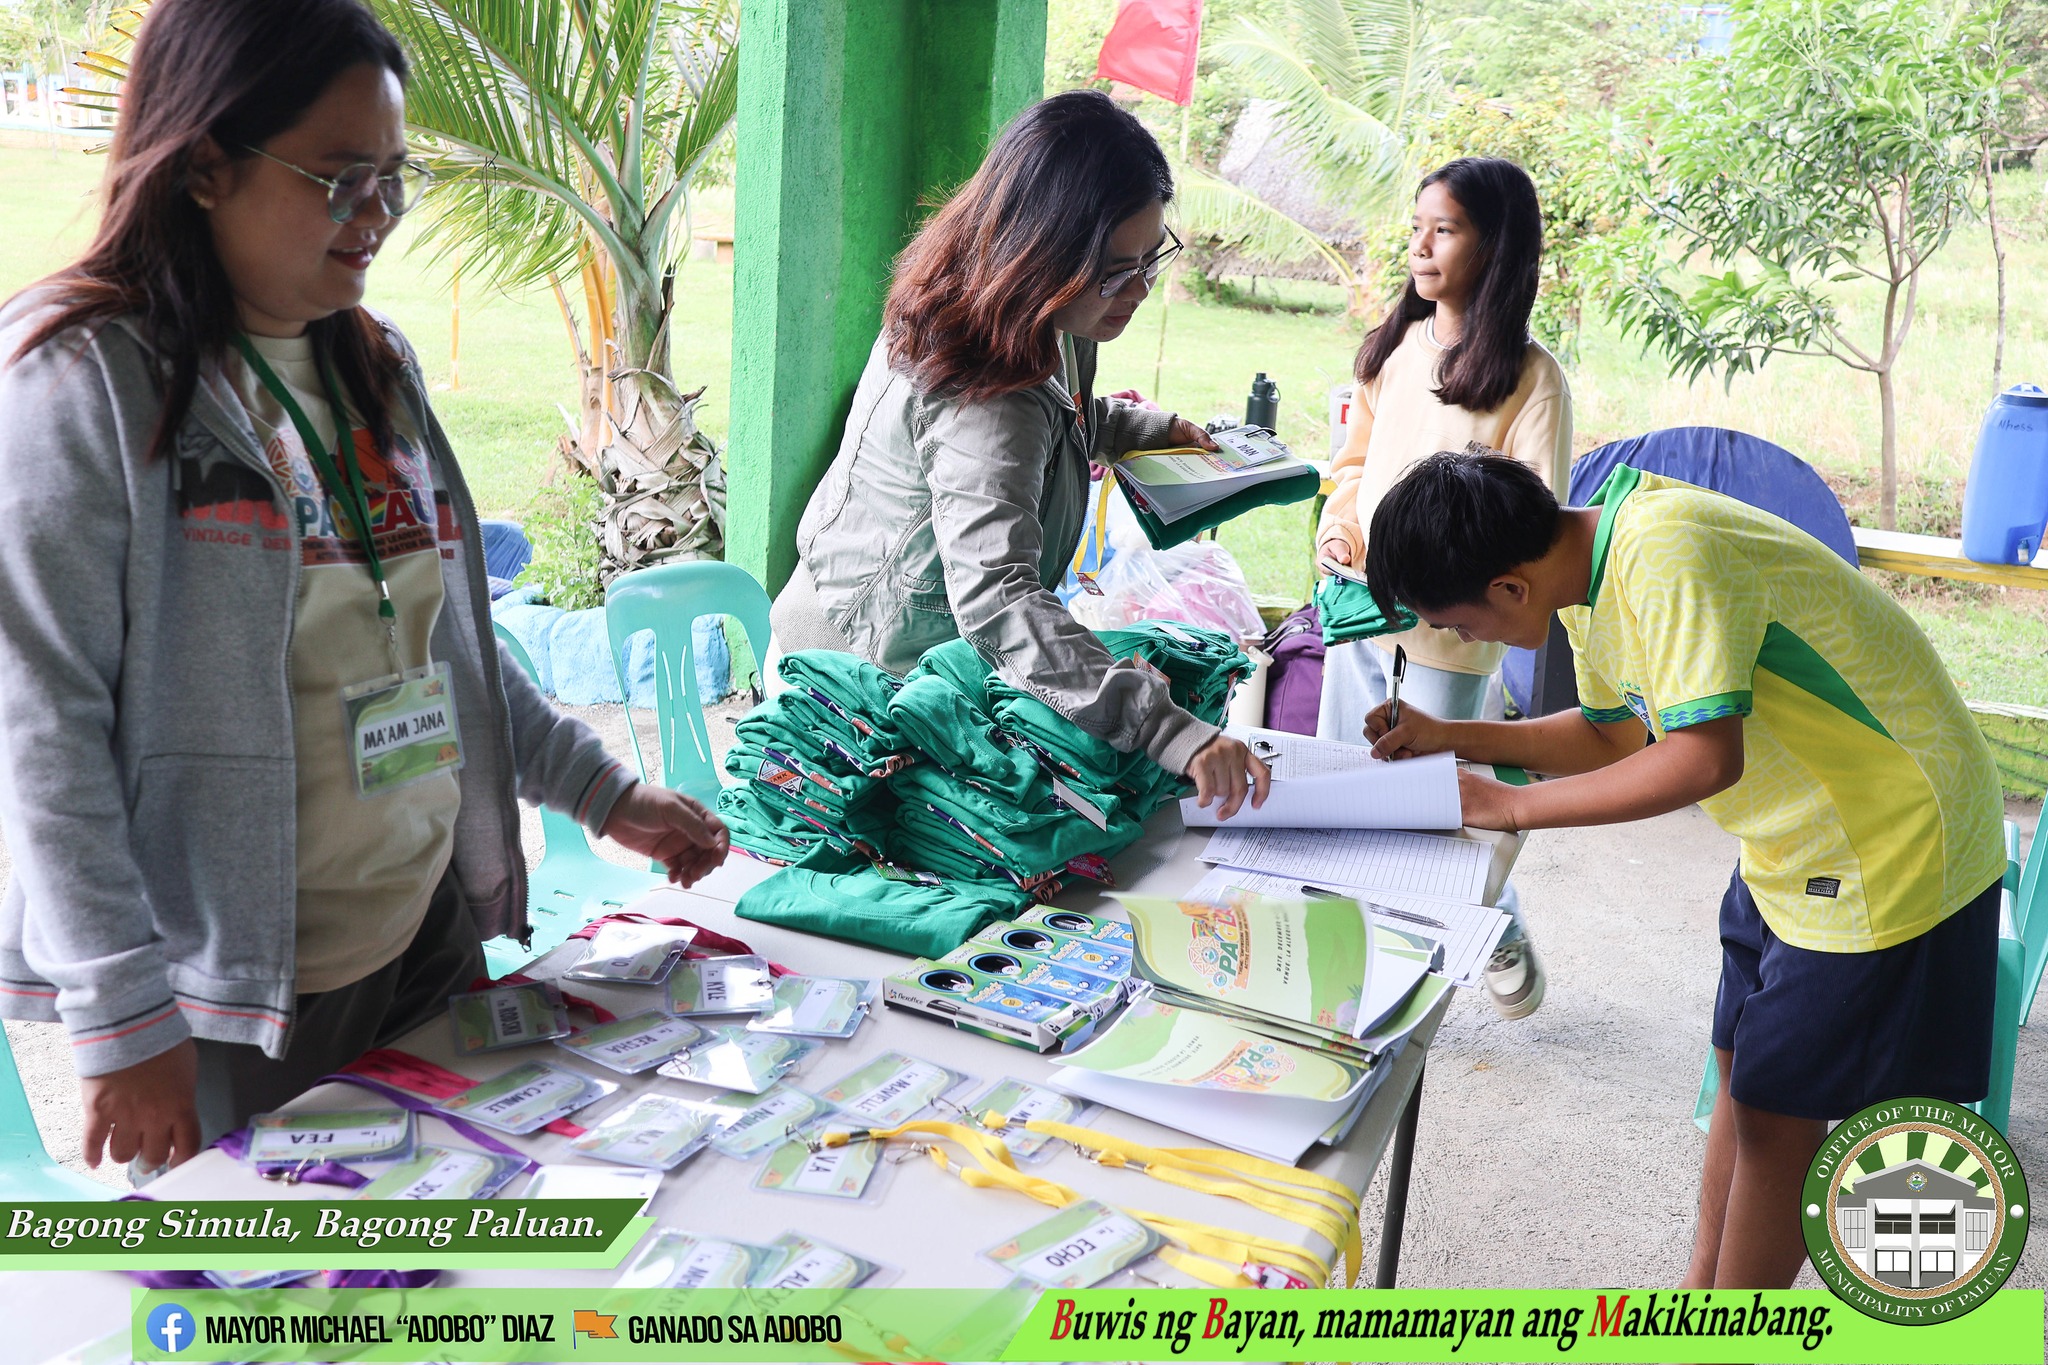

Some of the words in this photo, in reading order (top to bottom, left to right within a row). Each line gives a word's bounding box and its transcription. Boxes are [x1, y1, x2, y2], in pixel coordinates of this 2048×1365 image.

[182, 528, 251, 546] VINTAGE
[364, 721, 409, 750] MA'AM
[413, 710, 446, 735] JANA
[706, 981, 726, 1001] KYLE
[604, 1036, 659, 1055] RESHA
[484, 1086, 542, 1114] CAMILLE
[855, 1078, 911, 1113] MAVIELLE
[290, 1133, 335, 1144] FEA
[406, 1179, 444, 1200] JOY
[1045, 1238, 1097, 1267] ECHO
